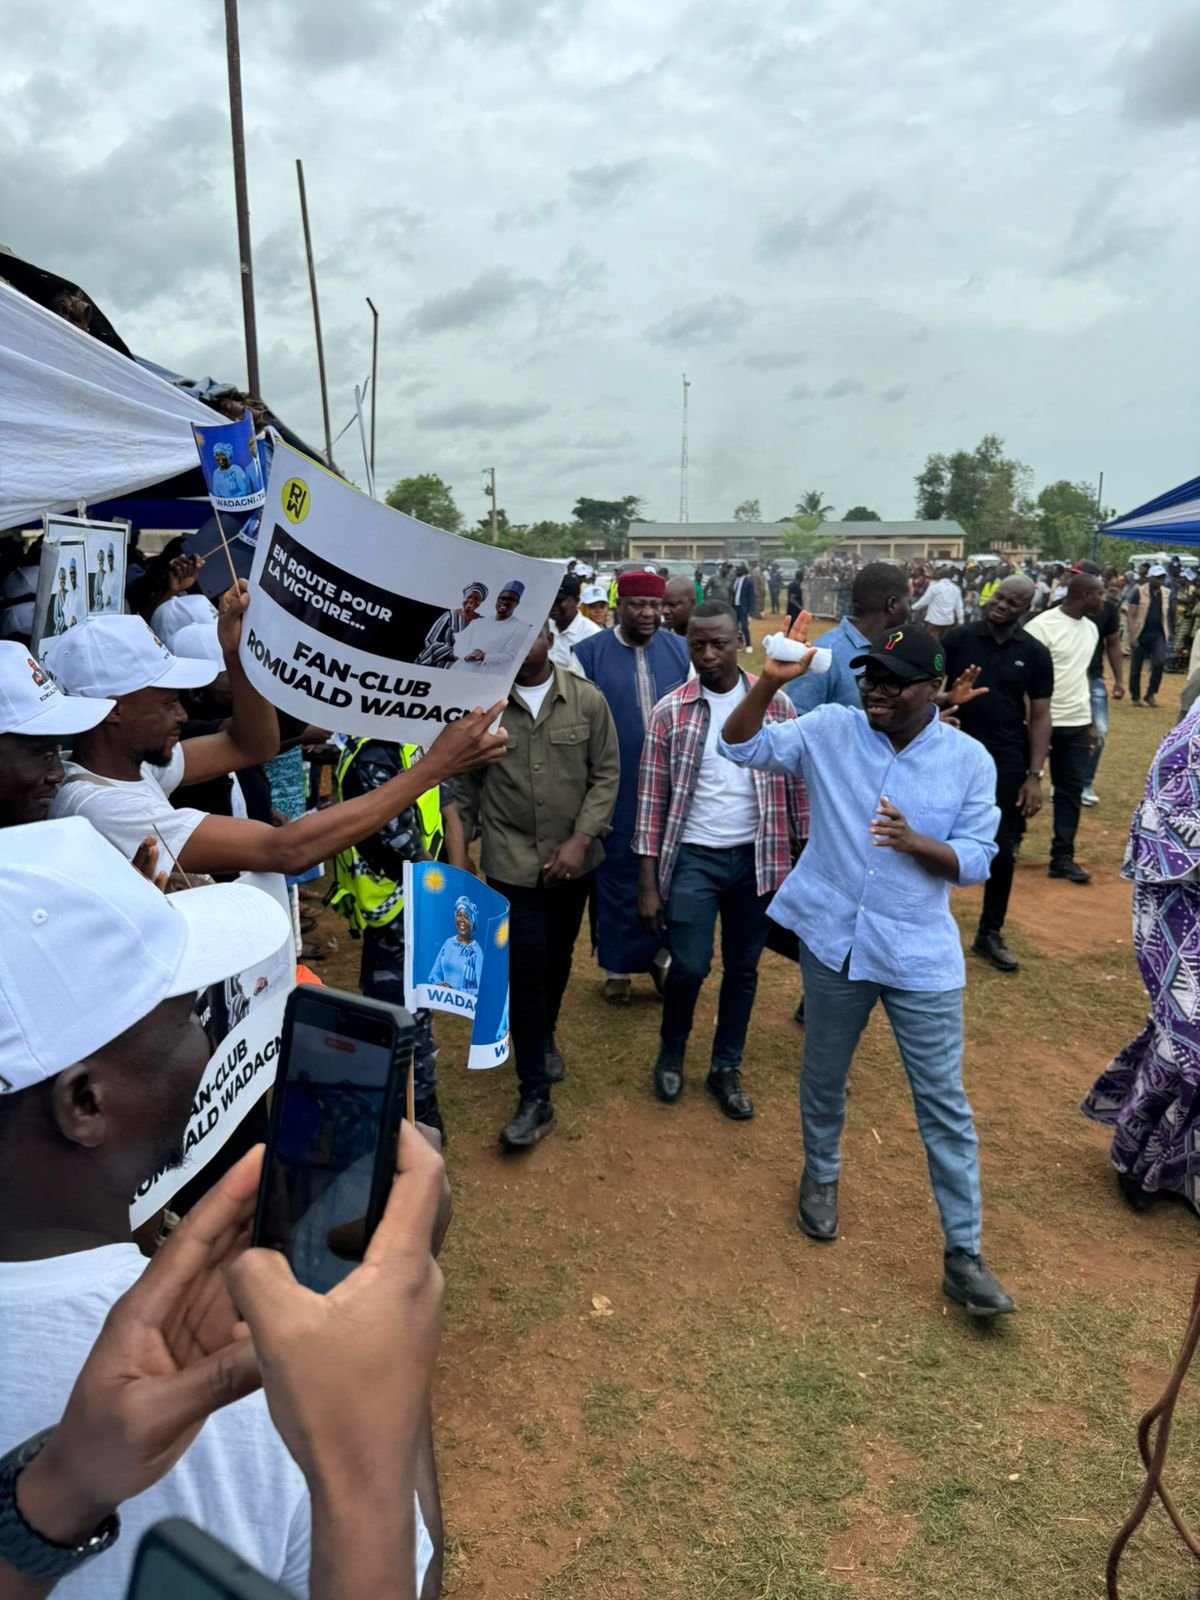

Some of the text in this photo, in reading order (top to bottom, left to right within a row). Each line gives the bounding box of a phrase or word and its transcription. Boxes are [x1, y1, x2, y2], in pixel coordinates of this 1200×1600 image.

[215, 496, 256, 508] WADAGNI
[267, 559, 366, 631] LA VICTOIRE...
[272, 543, 393, 623] EN ROUTE POUR
[246, 628, 353, 708] ROMUALD
[292, 640, 432, 698] FAN-CLUB
[427, 988, 477, 1012] WADA
[190, 1038, 248, 1116] AN-CLUB
[220, 1035, 282, 1113] WADAGN
